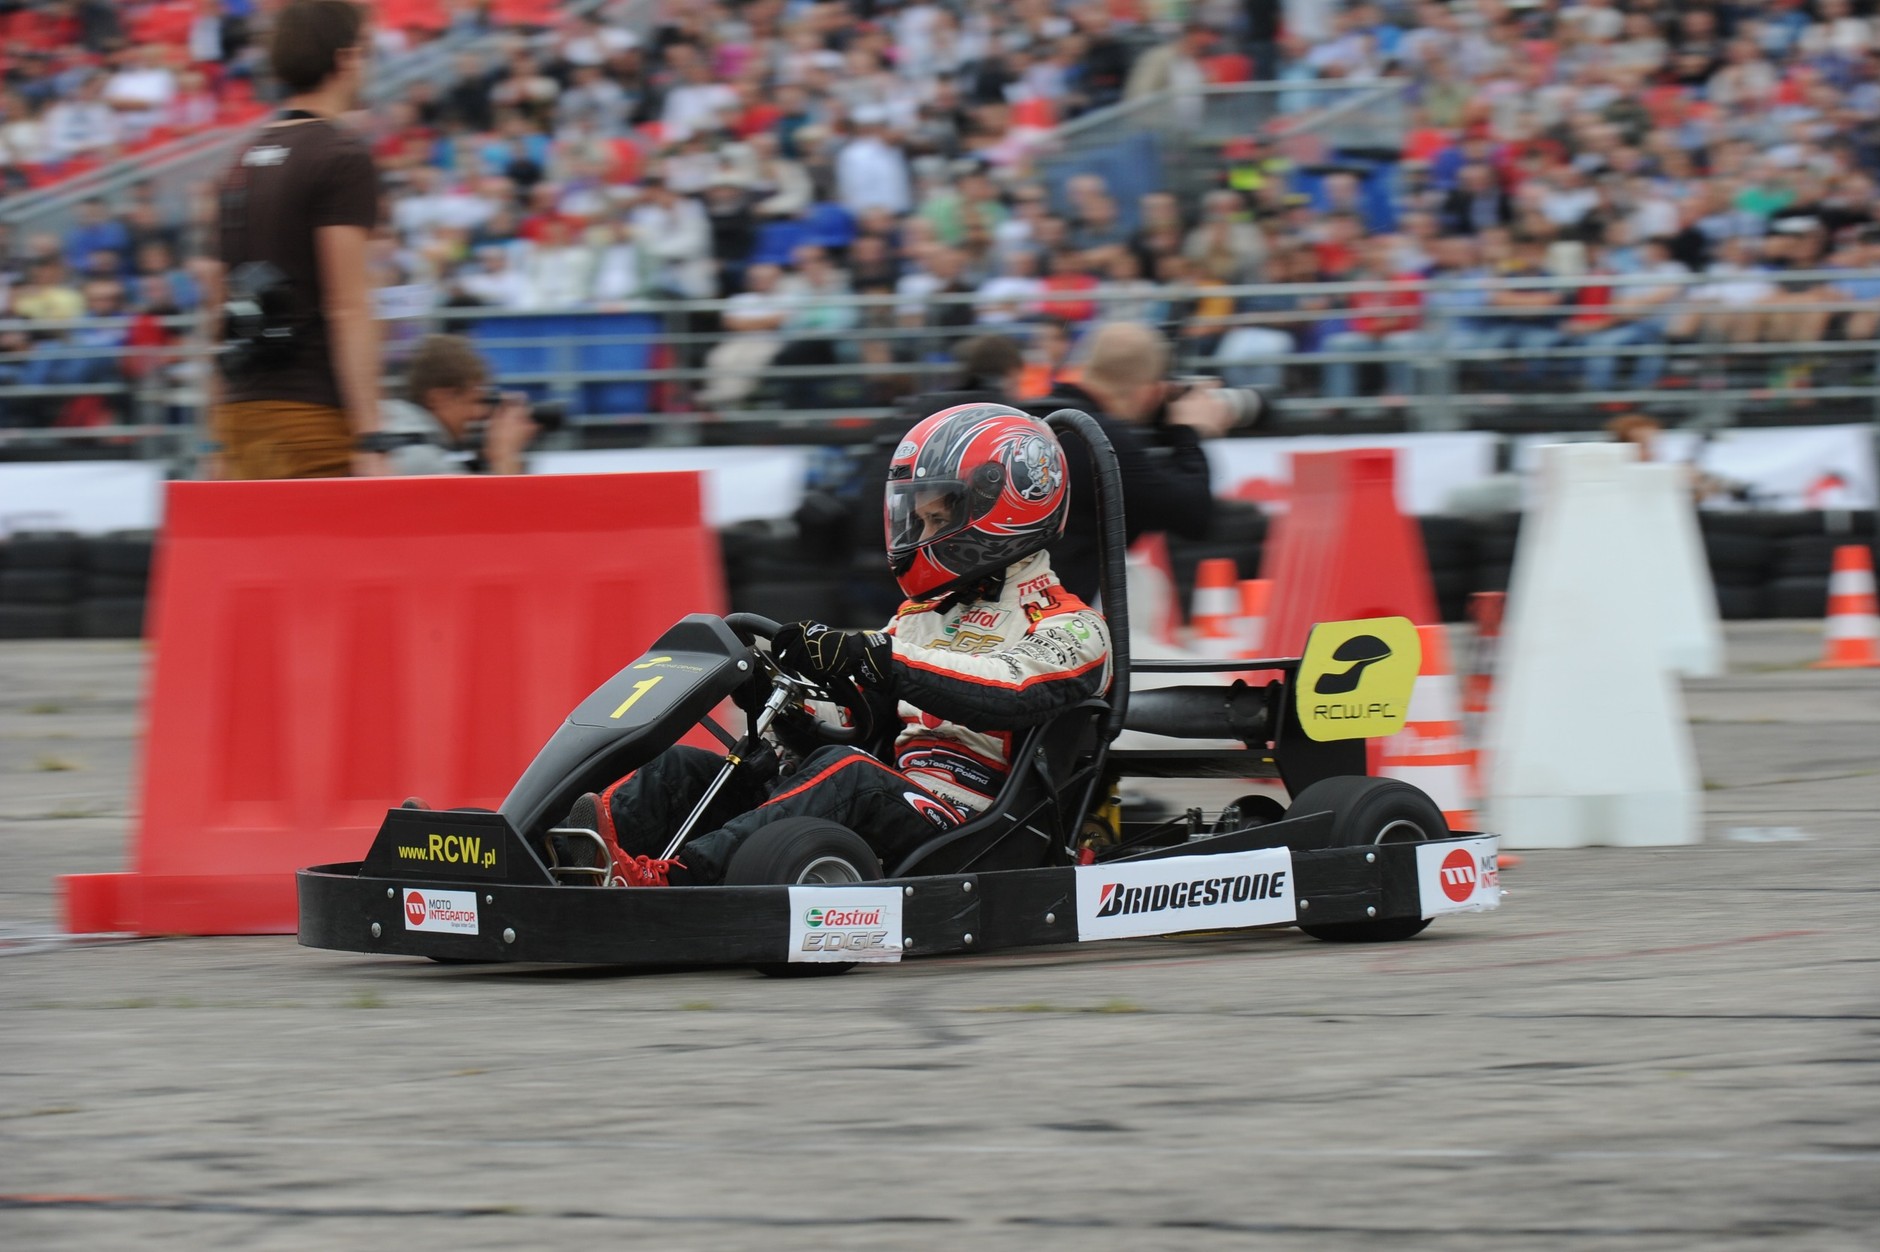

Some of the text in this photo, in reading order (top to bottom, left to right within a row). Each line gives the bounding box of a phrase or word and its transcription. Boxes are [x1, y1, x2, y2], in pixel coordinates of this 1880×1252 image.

[609, 675, 664, 719] 1
[928, 759, 954, 771] Team
[954, 766, 989, 785] Poland
[399, 834, 496, 868] www.RCW.pl
[429, 899, 452, 910] MOTO
[1096, 871, 1286, 918] BRIDGESTONE
[429, 910, 476, 922] INTEGRATOR
[824, 908, 881, 927] Castrol
[801, 931, 888, 951] EDGE
